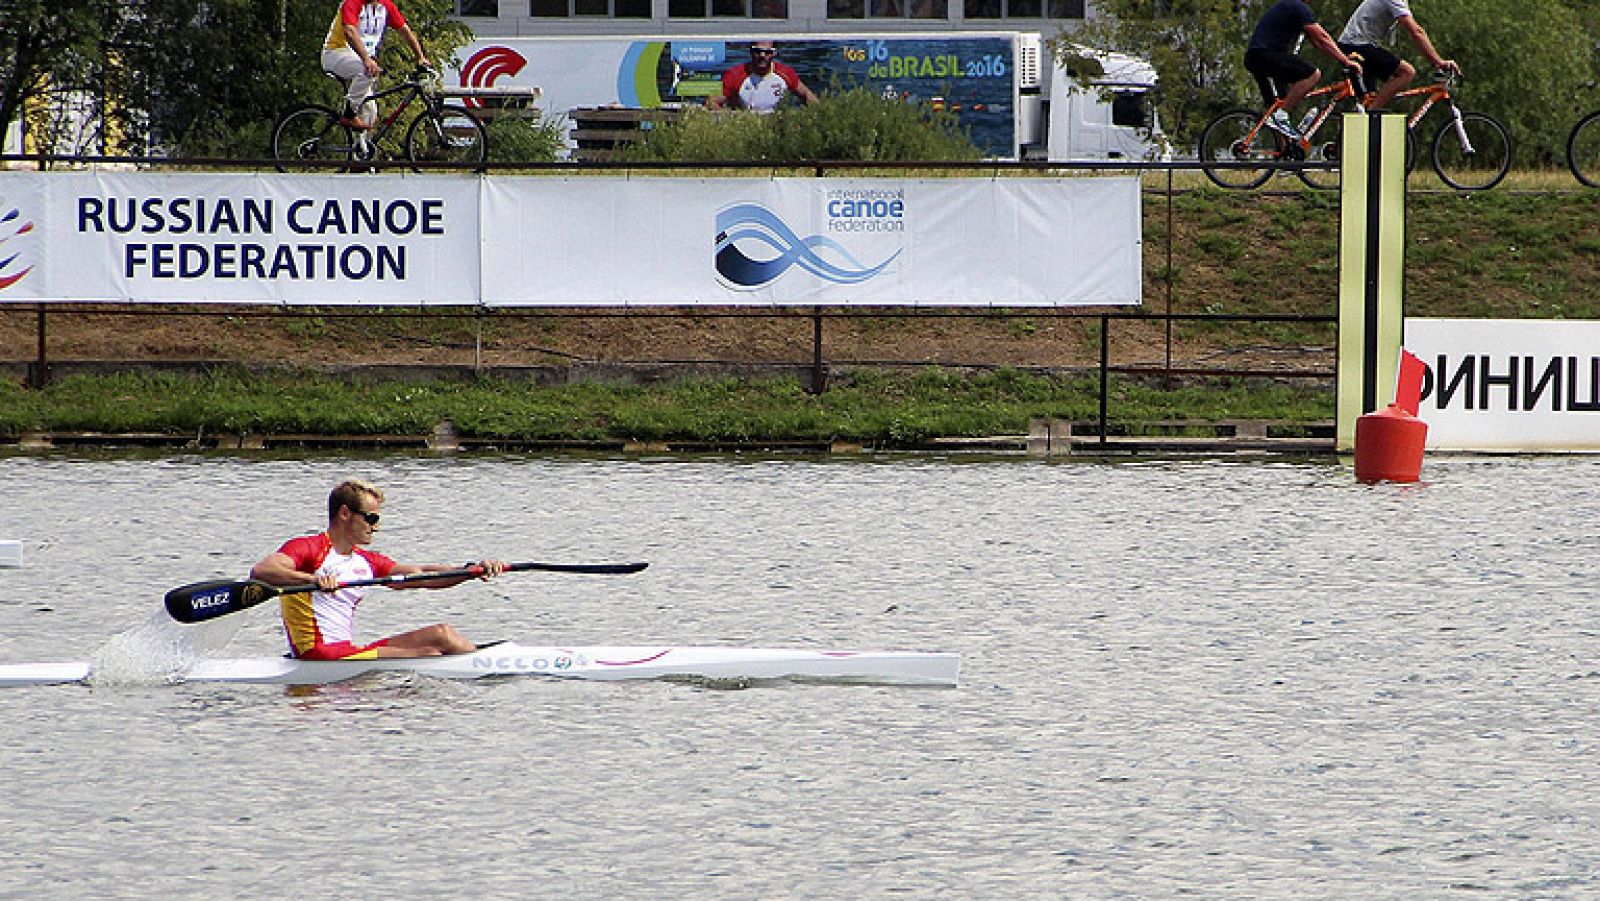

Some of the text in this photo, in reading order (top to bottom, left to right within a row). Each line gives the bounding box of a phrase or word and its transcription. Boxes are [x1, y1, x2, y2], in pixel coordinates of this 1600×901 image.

[843, 39, 888, 61] los 16
[869, 54, 1005, 78] de BRASIL 2016
[828, 187, 904, 200] international
[78, 197, 445, 234] RUSSIAN CANOE
[828, 200, 904, 218] canoe
[828, 218, 905, 232] federation
[125, 243, 405, 280] FEDERATION
[191, 591, 230, 610] VELEZ
